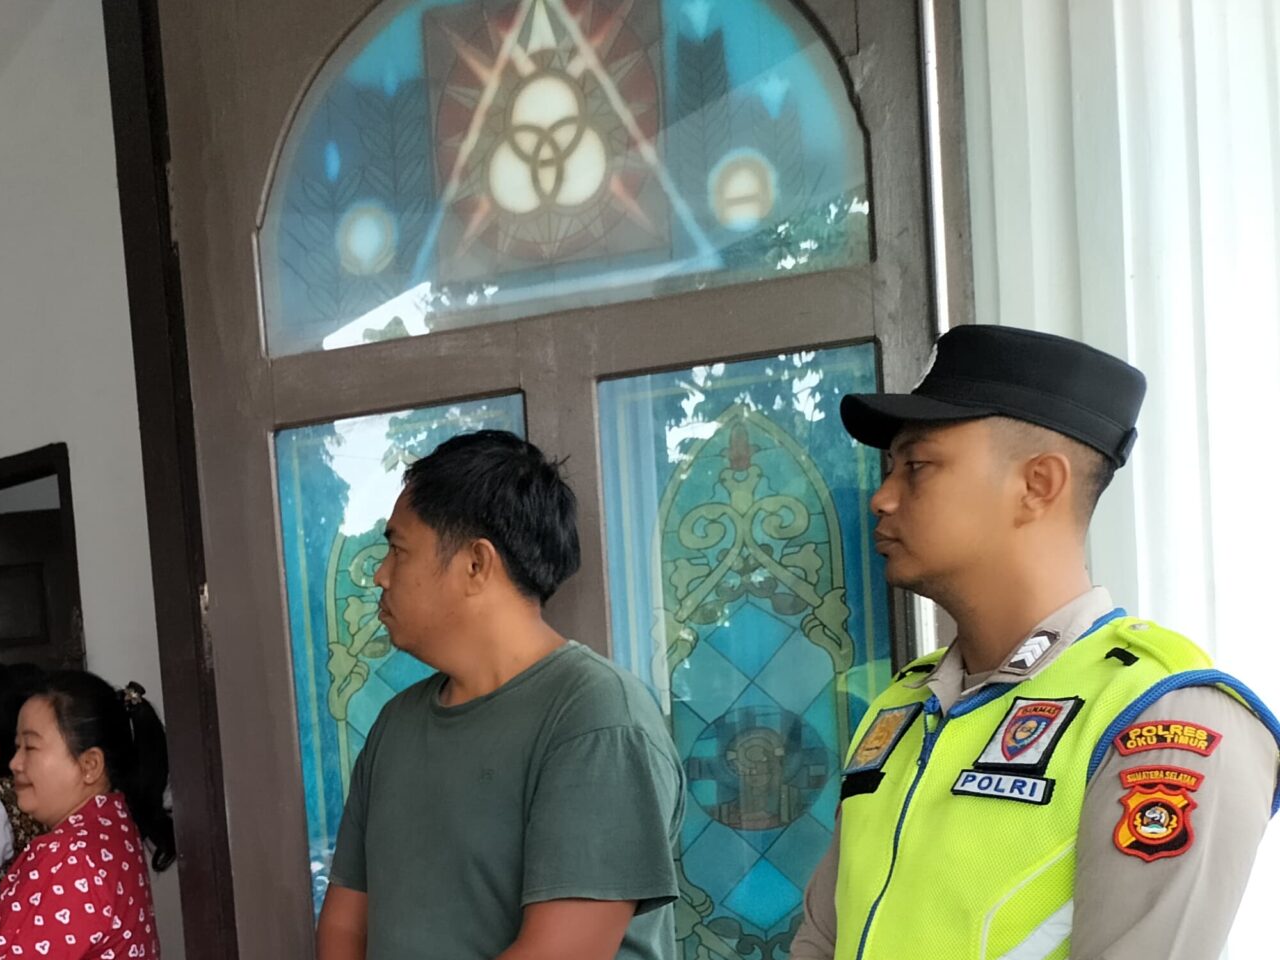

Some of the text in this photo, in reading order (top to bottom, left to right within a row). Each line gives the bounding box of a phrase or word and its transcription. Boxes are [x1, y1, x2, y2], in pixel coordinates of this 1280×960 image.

[1129, 724, 1208, 741] POLRES
[1126, 734, 1208, 750] OKU TIMUR
[960, 774, 1038, 797] POLRI
[1126, 770, 1198, 786] SUMATERA SELATAN
